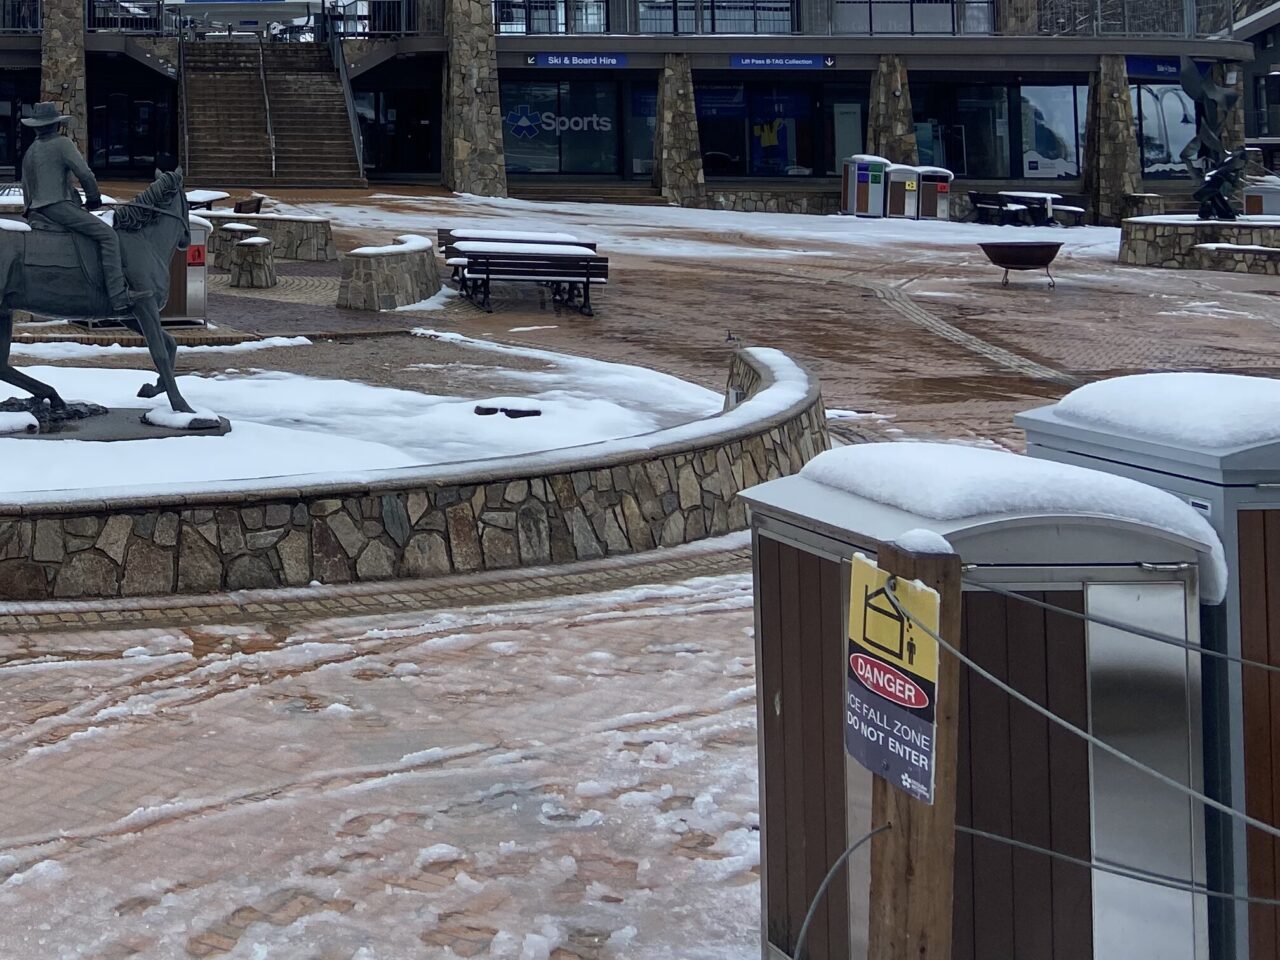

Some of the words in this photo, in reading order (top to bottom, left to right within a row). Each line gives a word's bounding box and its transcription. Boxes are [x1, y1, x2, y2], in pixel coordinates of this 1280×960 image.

[548, 56, 562, 64] Ski
[571, 56, 597, 64] Board
[599, 57, 617, 65] Hire
[541, 112, 612, 136] Sports
[857, 657, 916, 704] DANGER
[847, 691, 861, 713] ICE
[862, 703, 892, 731] FALL
[893, 719, 931, 752] ZONE
[847, 710, 860, 730] DO
[860, 721, 885, 746] NOT
[888, 737, 929, 772] ENTER
